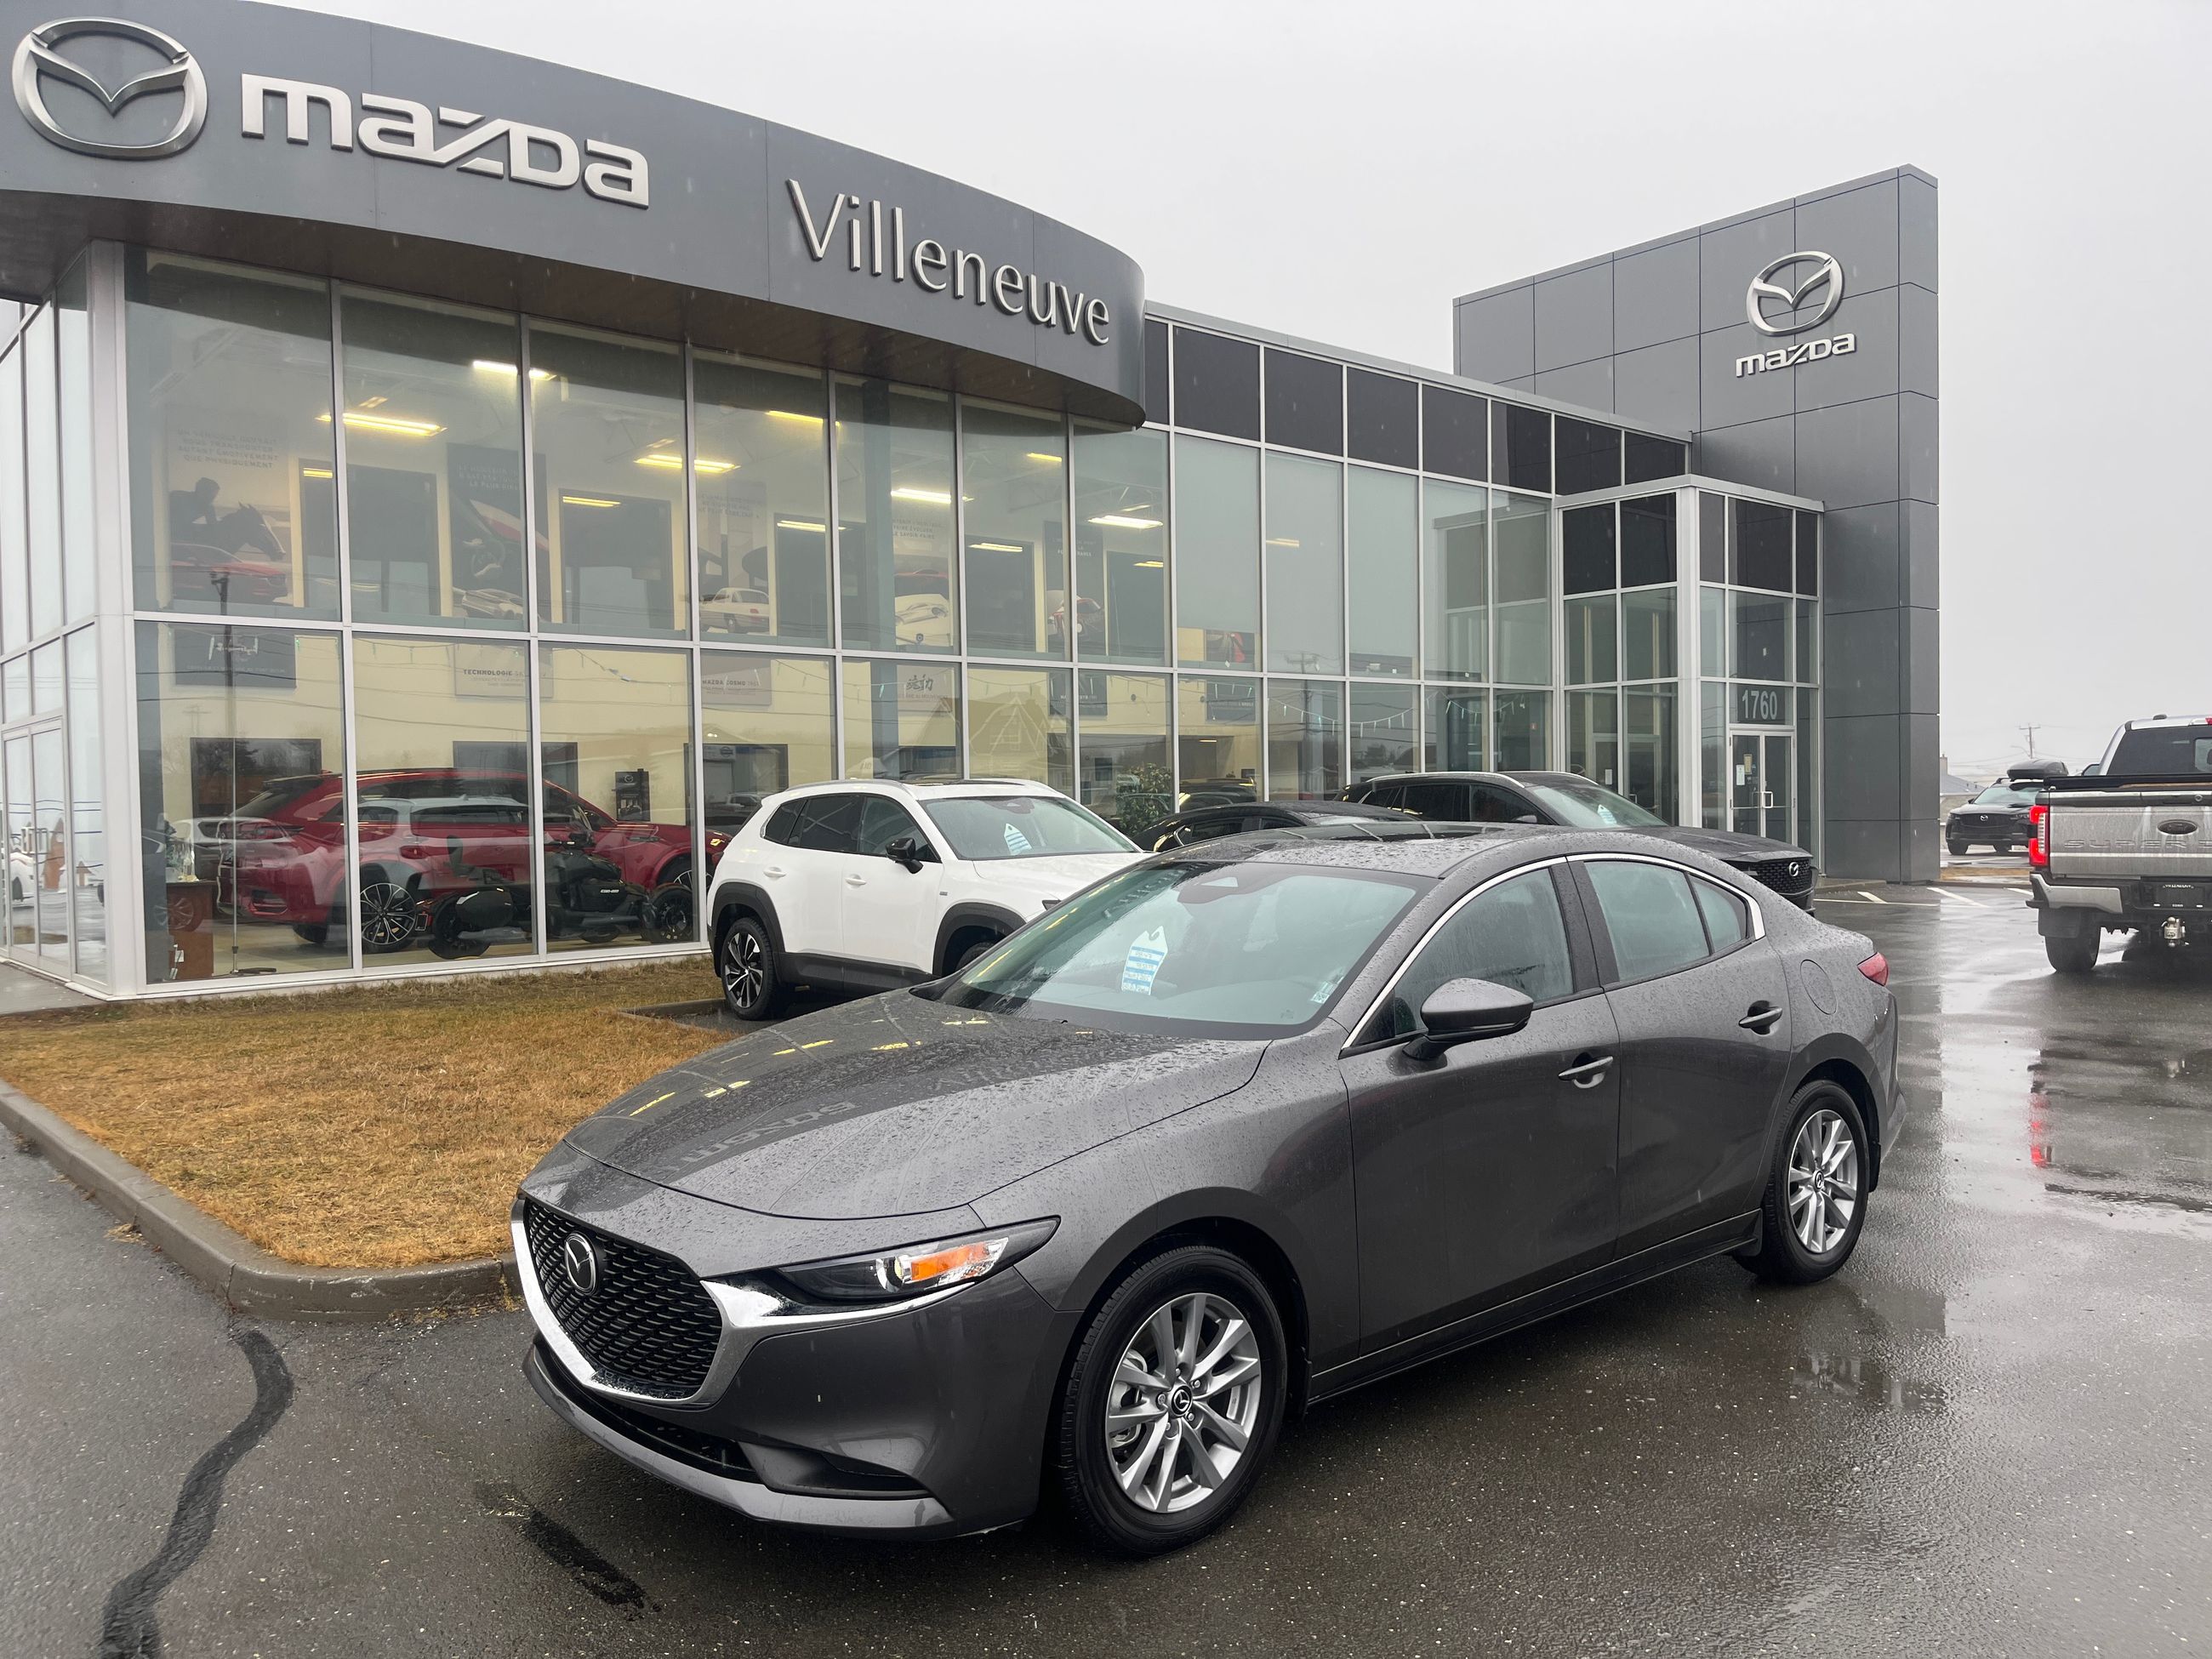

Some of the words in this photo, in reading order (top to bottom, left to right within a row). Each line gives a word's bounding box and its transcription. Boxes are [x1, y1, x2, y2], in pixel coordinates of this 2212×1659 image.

[786, 177, 1112, 346] Villeneuve
[1742, 689, 1778, 721] 1760
[2064, 839, 2188, 849] SUPER
